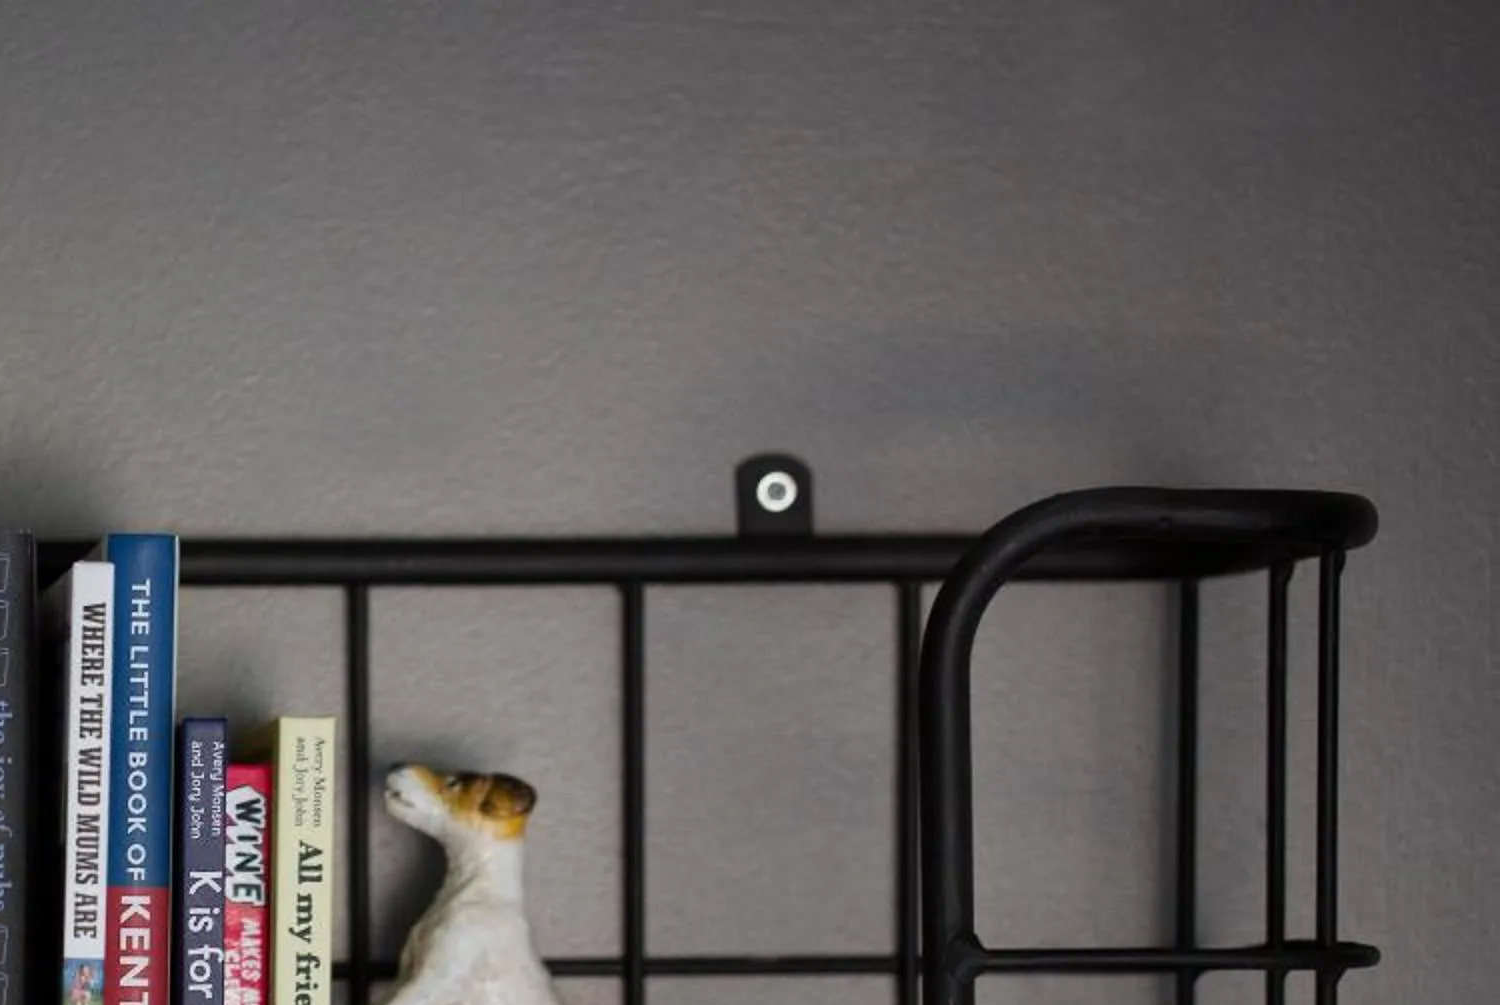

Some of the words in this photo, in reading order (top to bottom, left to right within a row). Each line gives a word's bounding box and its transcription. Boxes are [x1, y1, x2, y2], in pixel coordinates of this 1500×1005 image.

[131, 579, 151, 635] THE
[80, 603, 106, 686] WHERE
[80, 694, 103, 739] THE
[129, 645, 149, 741] LITTLE
[77, 748, 101, 807] WILD
[190, 740, 205, 767] and
[127, 751, 147, 835] BOOK
[187, 772, 205, 801] Jory
[312, 777, 326, 828] Monsen
[190, 806, 205, 839] John
[76, 814, 100, 885] MUMS
[126, 843, 146, 881] OF
[232, 798, 263, 903] WINE
[298, 840, 323, 885] All
[188, 870, 222, 896] K
[74, 893, 97, 939] ARE
[188, 907, 221, 933] is
[288, 893, 314, 943] my
[187, 946, 225, 1000] for
[241, 920, 262, 982] MAKES
